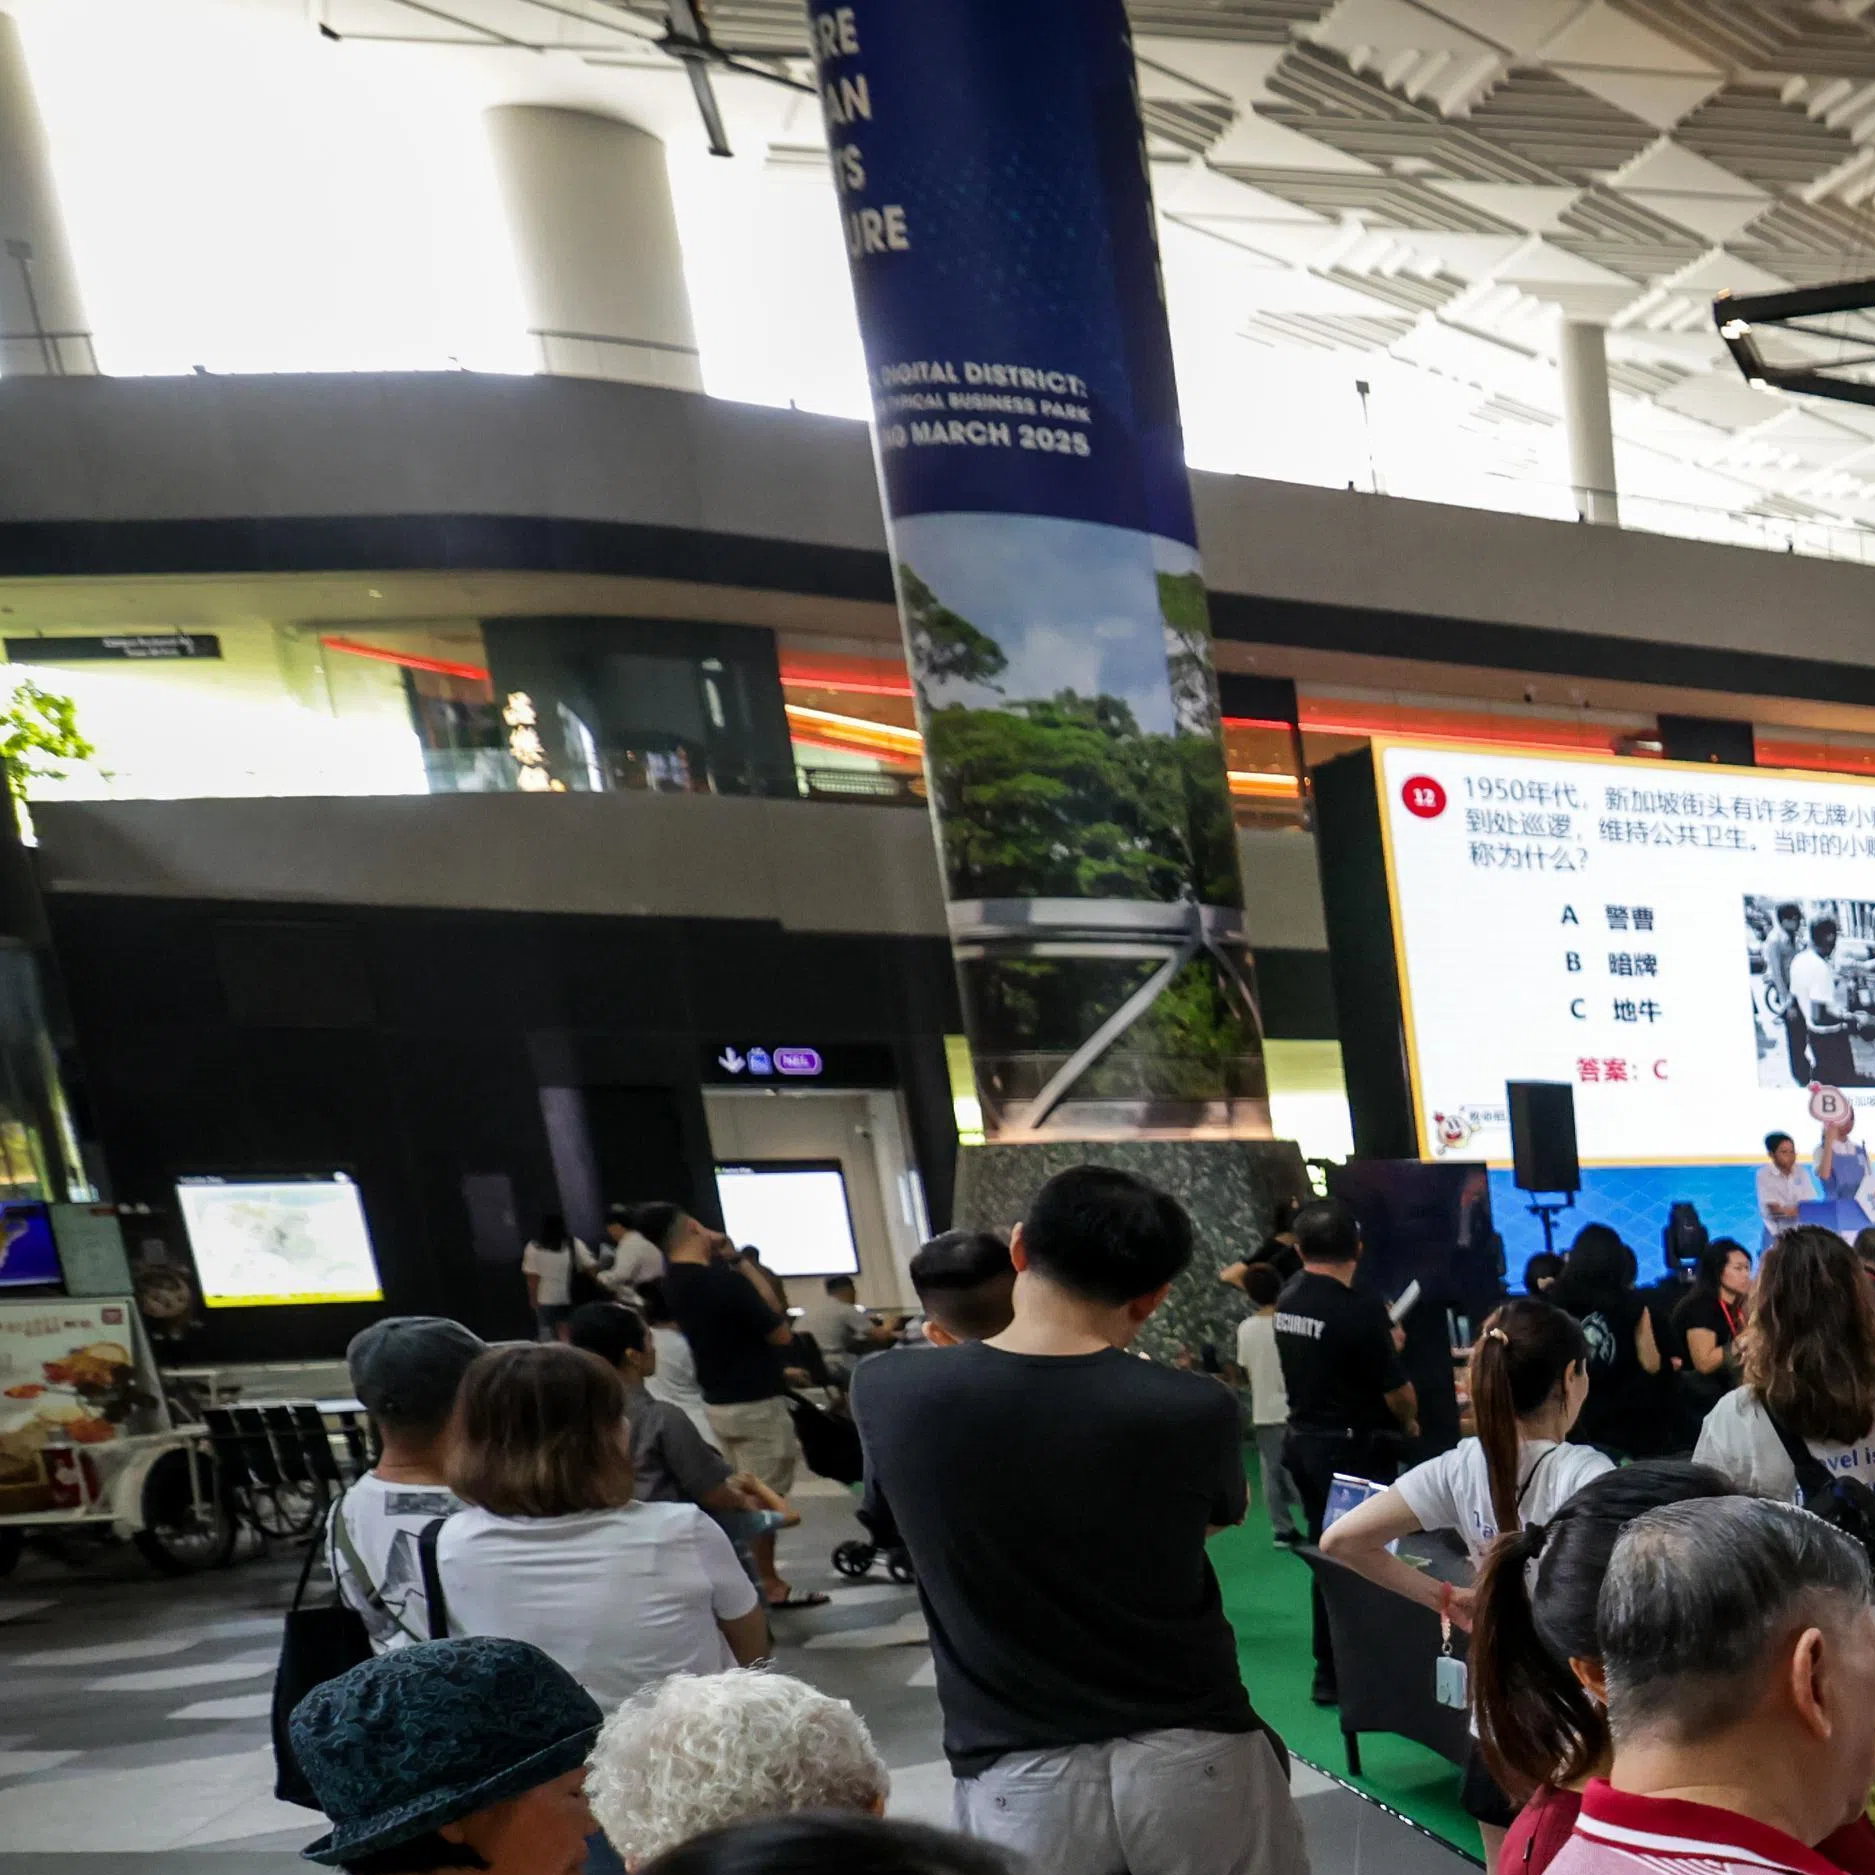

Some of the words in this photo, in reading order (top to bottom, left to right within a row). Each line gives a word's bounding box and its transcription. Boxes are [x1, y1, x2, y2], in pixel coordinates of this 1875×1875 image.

[963, 361, 1088, 398] DISTRICT:
[947, 392, 1037, 416] BUSINESS
[1040, 399, 1092, 424] PARK
[910, 420, 1012, 447] MARCH
[1017, 423, 1091, 457] 2025
[1413, 786, 1437, 808] 12
[1561, 904, 1579, 926] A
[1605, 904, 1654, 931] 警曹
[1566, 951, 1582, 973] B
[1608, 951, 1658, 977] 暗牌
[1570, 998, 1587, 1019] C
[1613, 997, 1662, 1023] 地牛
[1822, 1095, 1837, 1113] B
[1275, 1311, 1326, 1340] ECURITY
